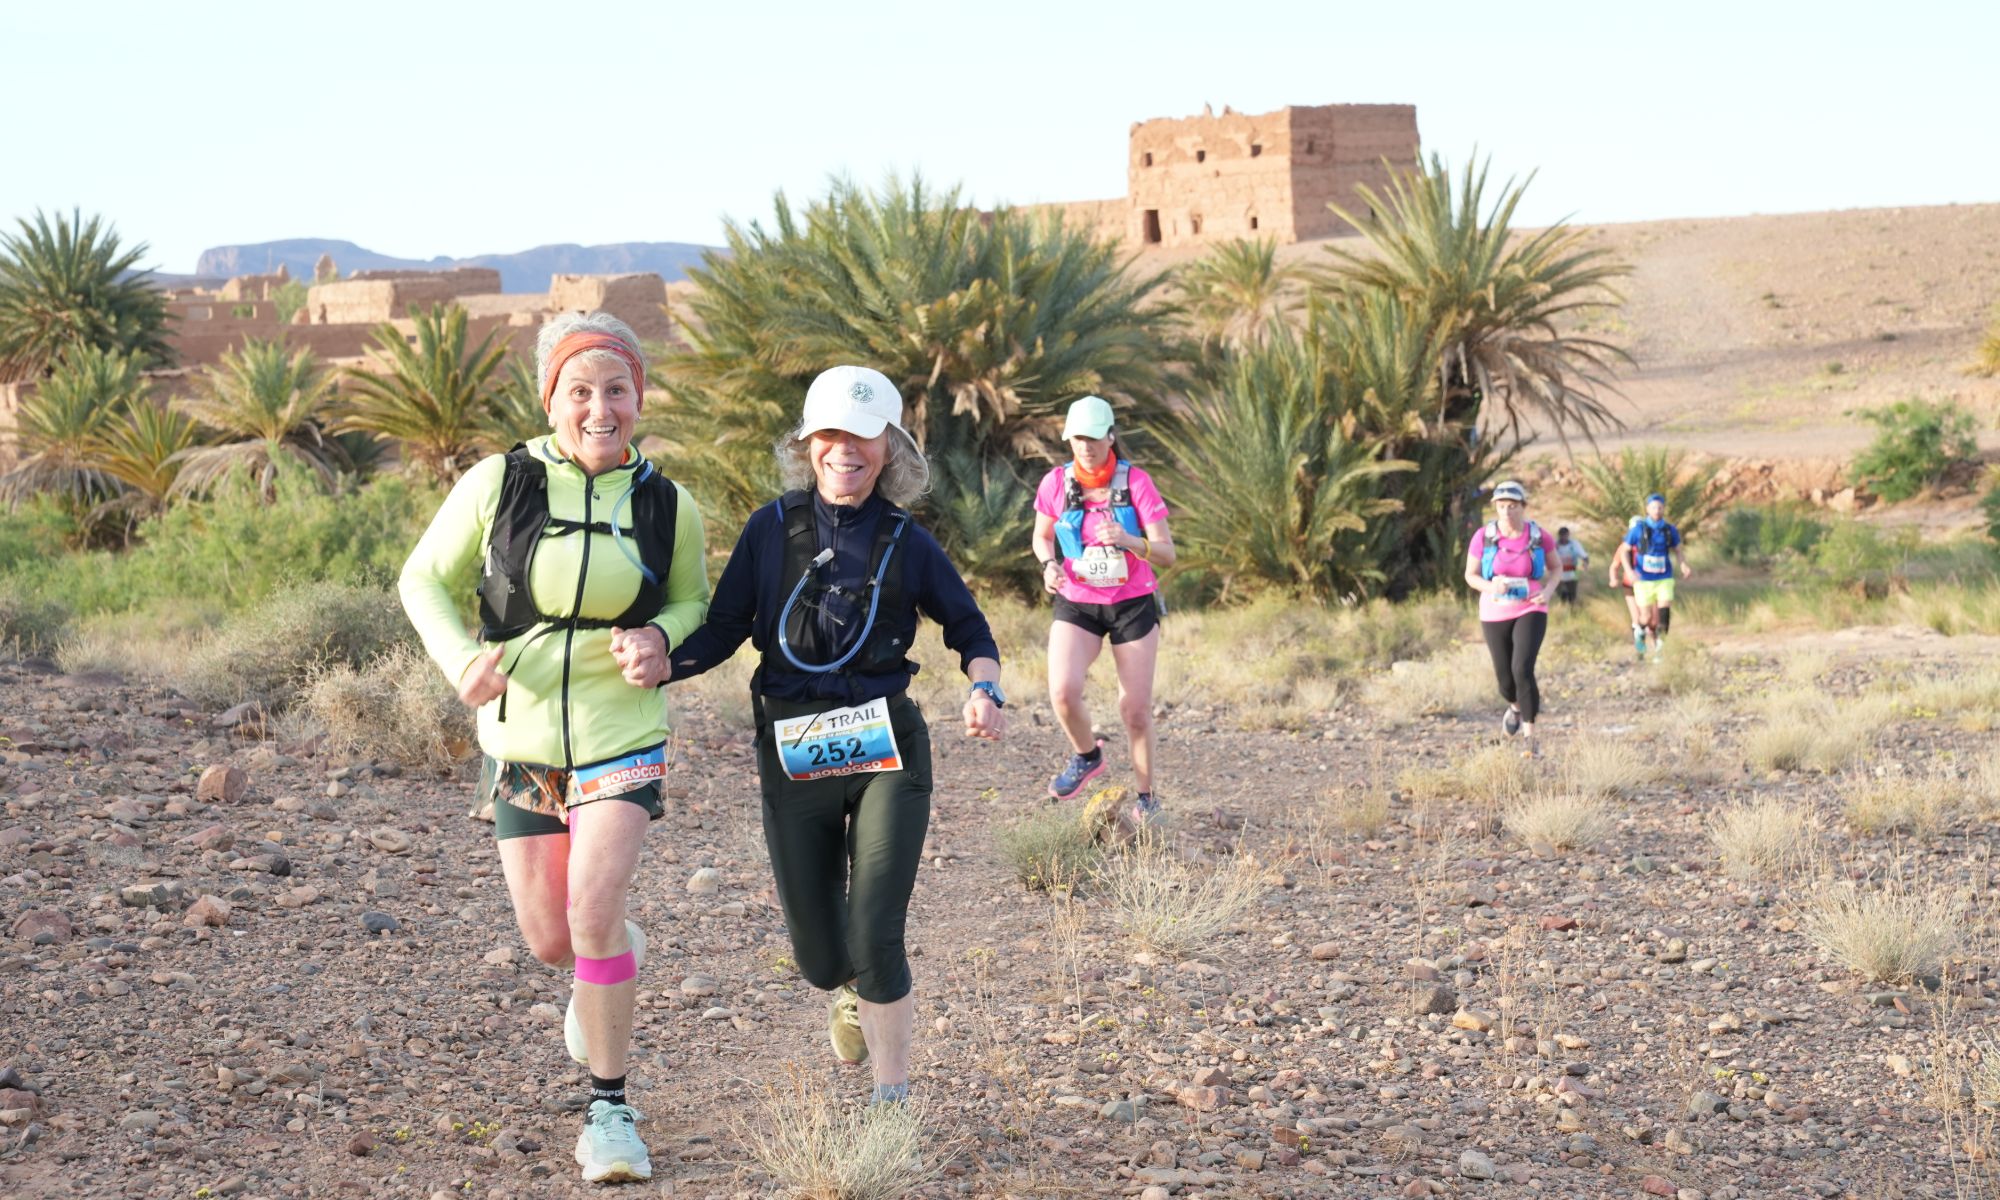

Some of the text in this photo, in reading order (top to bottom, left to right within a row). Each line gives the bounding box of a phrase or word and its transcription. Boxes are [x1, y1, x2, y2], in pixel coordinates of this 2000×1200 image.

[1089, 561, 1108, 575] 99
[827, 707, 881, 729] TRAIL
[808, 737, 866, 766] 252
[598, 765, 661, 788] MOROCCO
[808, 760, 883, 778] MOROCCO
